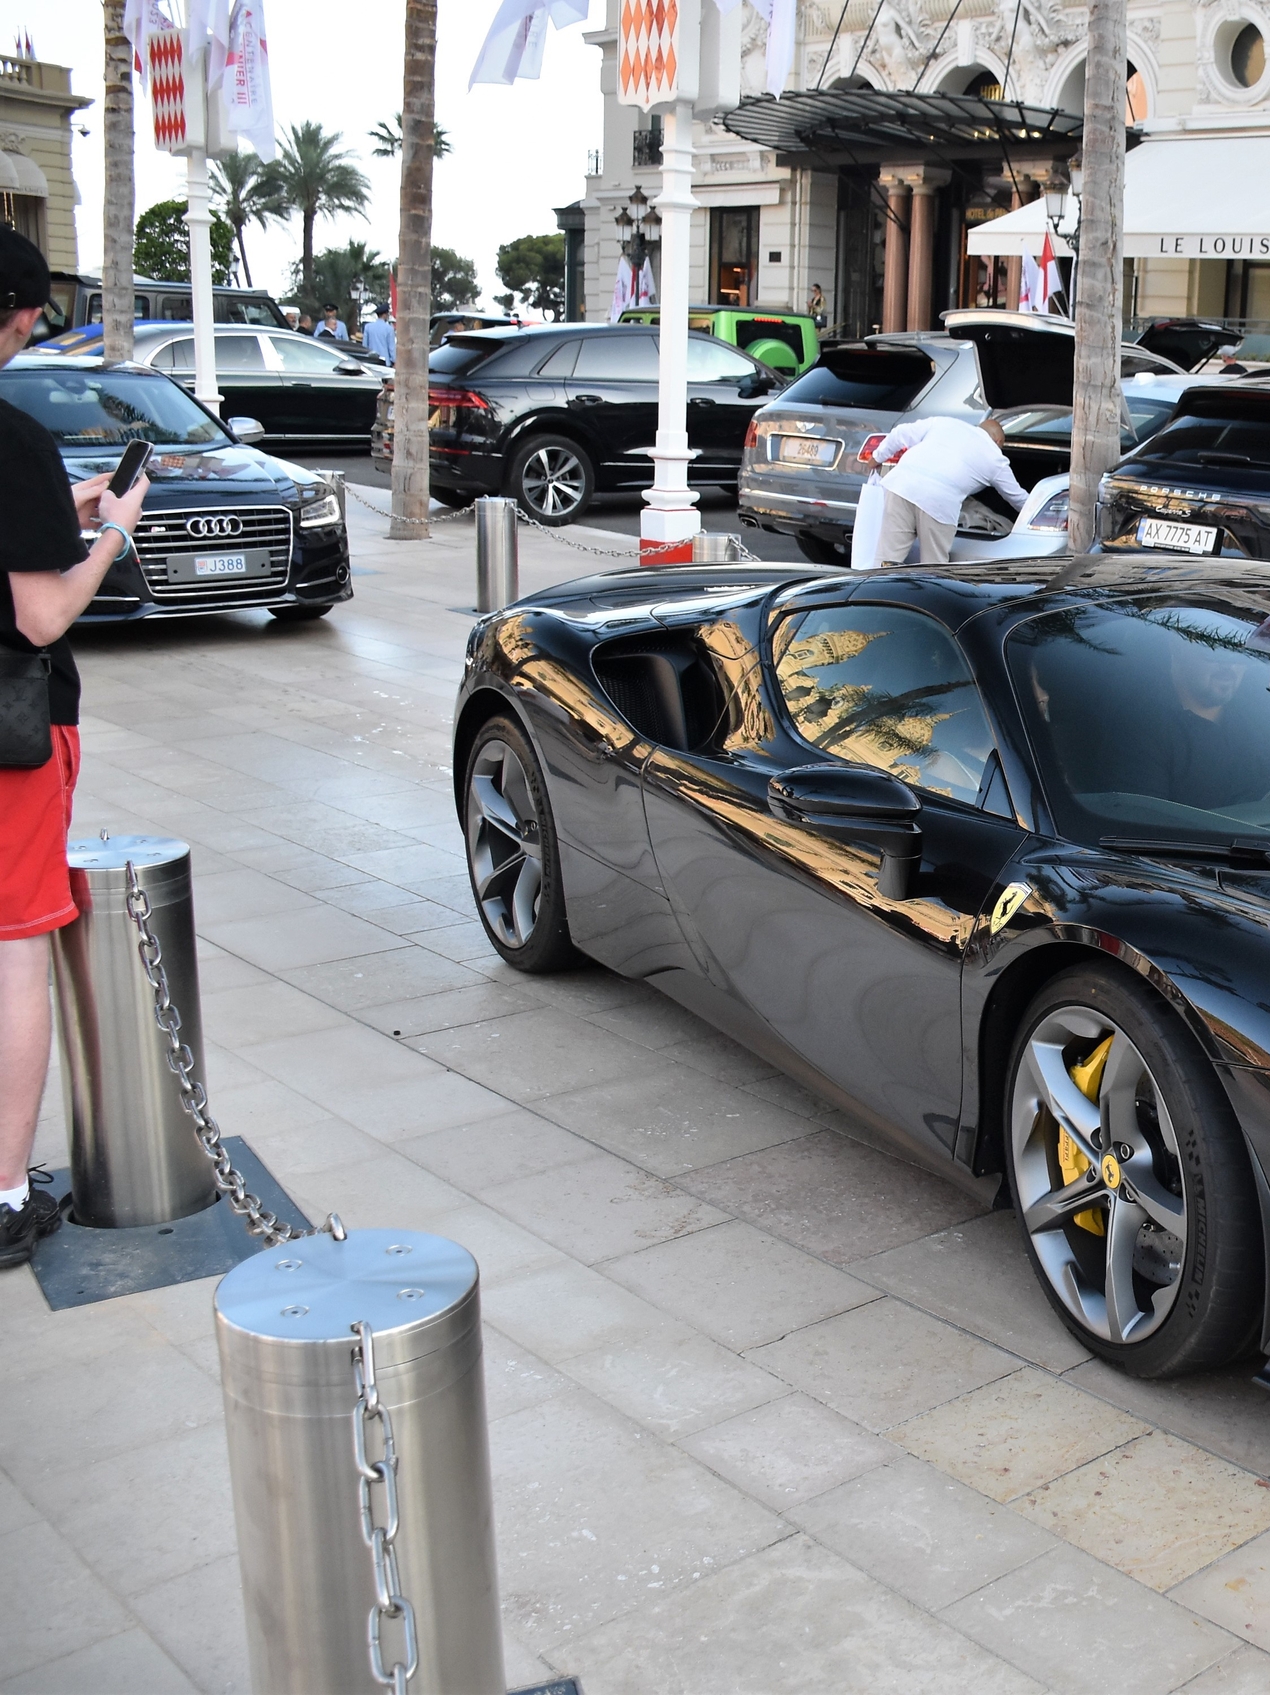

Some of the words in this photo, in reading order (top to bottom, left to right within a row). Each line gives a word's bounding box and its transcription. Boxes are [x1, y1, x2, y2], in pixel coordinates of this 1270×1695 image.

[1160, 237, 1184, 254] LE
[1199, 237, 1270, 254] LOUIS
[1140, 485, 1221, 501] PORSCHE
[1145, 522, 1162, 540] AX
[1164, 525, 1192, 544] 7775
[1193, 530, 1213, 547] AT
[210, 558, 243, 572] J388
[1193, 1197, 1207, 1284] MICHELIN
